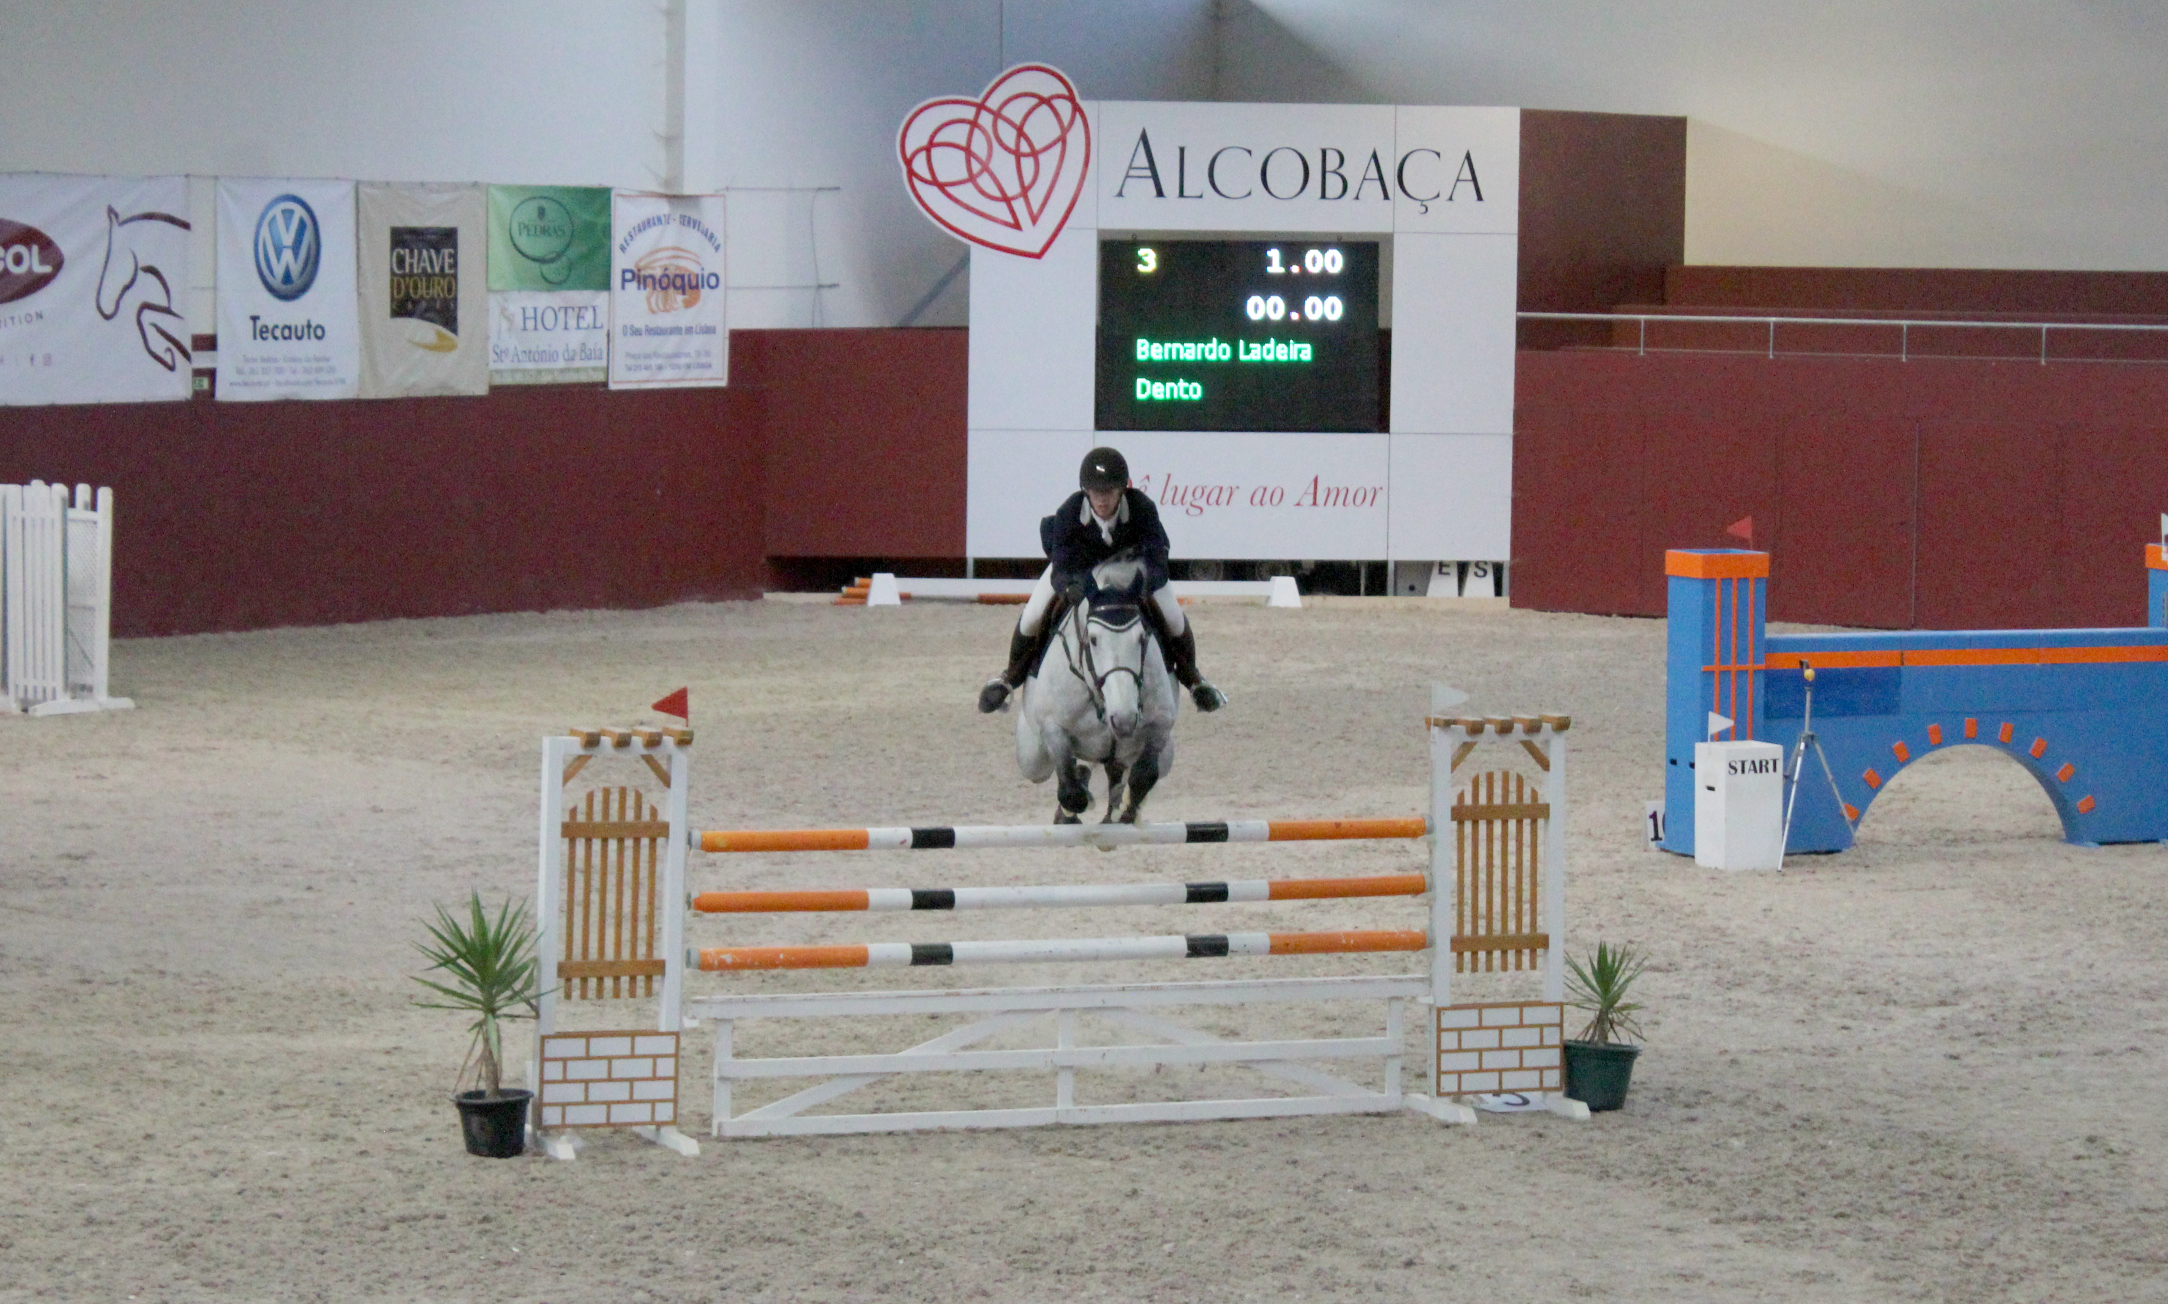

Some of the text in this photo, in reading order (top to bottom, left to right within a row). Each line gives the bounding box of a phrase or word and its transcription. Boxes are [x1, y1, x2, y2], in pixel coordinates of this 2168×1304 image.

[1114, 126, 1485, 215] ALCOBAÇA
[517, 221, 566, 237] PEDRAS
[392, 247, 455, 274] CHAVE
[1137, 248, 1343, 274] 3 1.00
[392, 276, 456, 299] D'OURO
[620, 266, 720, 296] Pinóquio
[0, 309, 44, 329] ITION
[520, 304, 604, 332] HOTEL
[1246, 295, 1343, 320] 00.00
[249, 314, 326, 341] Tecauto
[511, 343, 559, 364] António
[562, 342, 577, 361] da
[1136, 337, 1313, 361] Bernardo Ladeira
[1136, 378, 1203, 400] Dento
[1159, 473, 1240, 516] lugar
[1249, 484, 1285, 507] ao
[1293, 473, 1383, 507] Amor
[1473, 560, 1488, 578] S
[1728, 758, 1780, 776] START
